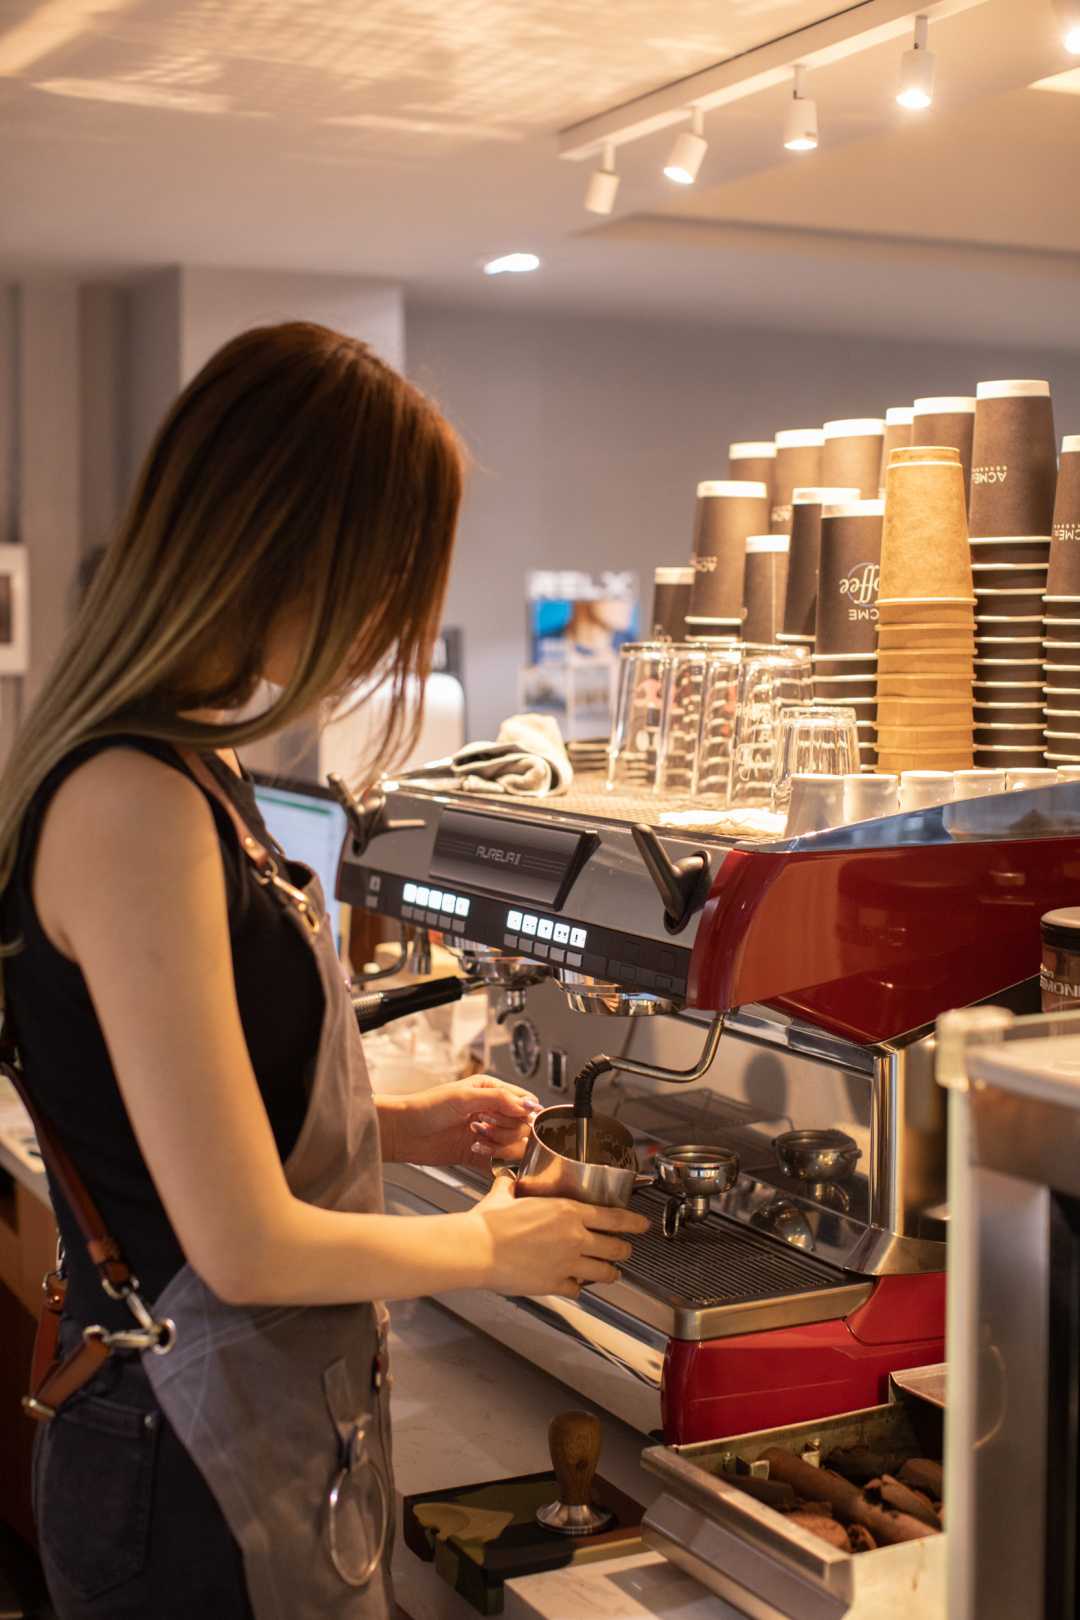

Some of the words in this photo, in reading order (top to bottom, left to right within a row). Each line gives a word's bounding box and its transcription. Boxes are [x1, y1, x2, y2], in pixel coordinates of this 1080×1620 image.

[974, 471, 1007, 485] ACME
[1058, 529, 1080, 541] CME
[839, 565, 880, 604] offee
[848, 608, 880, 621] CME
